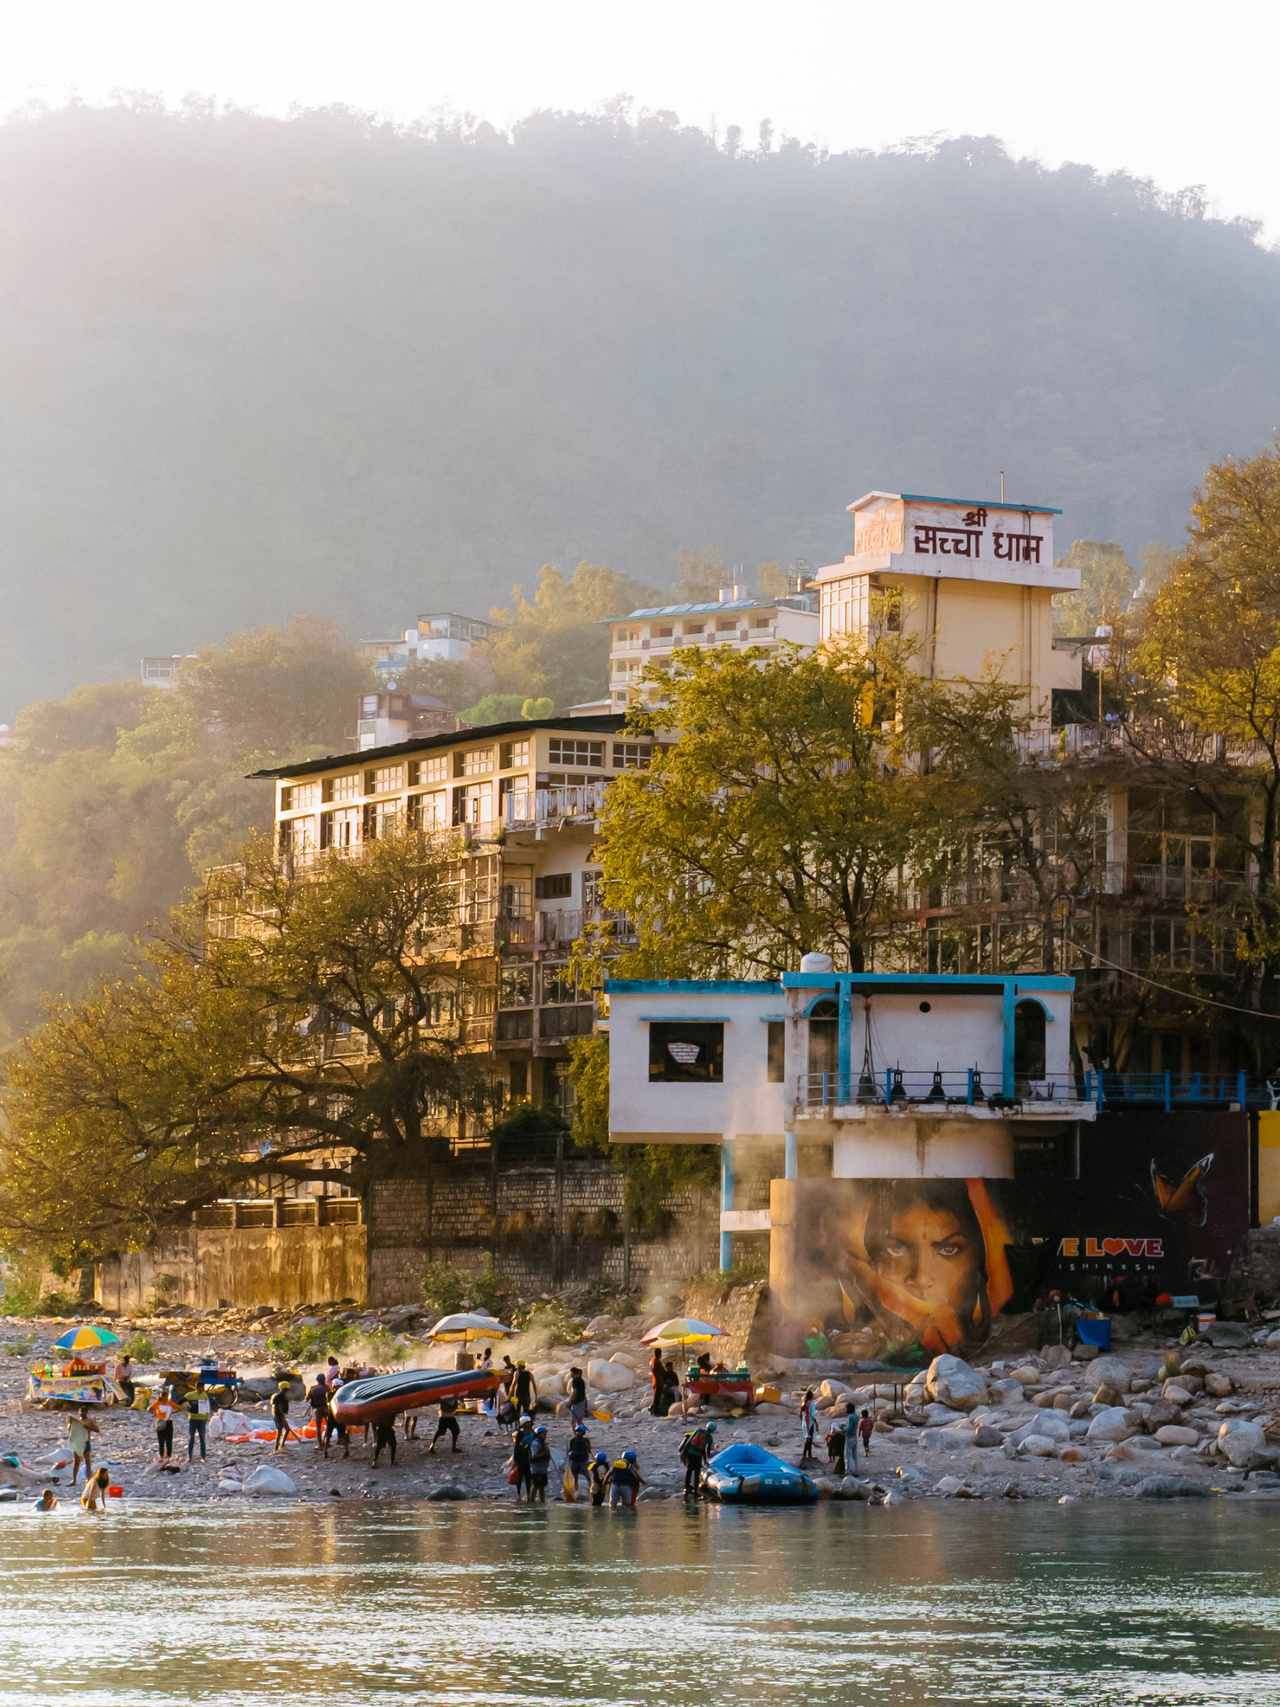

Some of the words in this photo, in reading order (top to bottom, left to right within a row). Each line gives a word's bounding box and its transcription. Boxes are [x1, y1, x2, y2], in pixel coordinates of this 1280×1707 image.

[962, 507, 988, 527] श्री
[914, 525, 983, 558] सच्चा
[992, 532, 1044, 563] धाम
[1058, 1263, 1155, 1271] ISHIKESH
